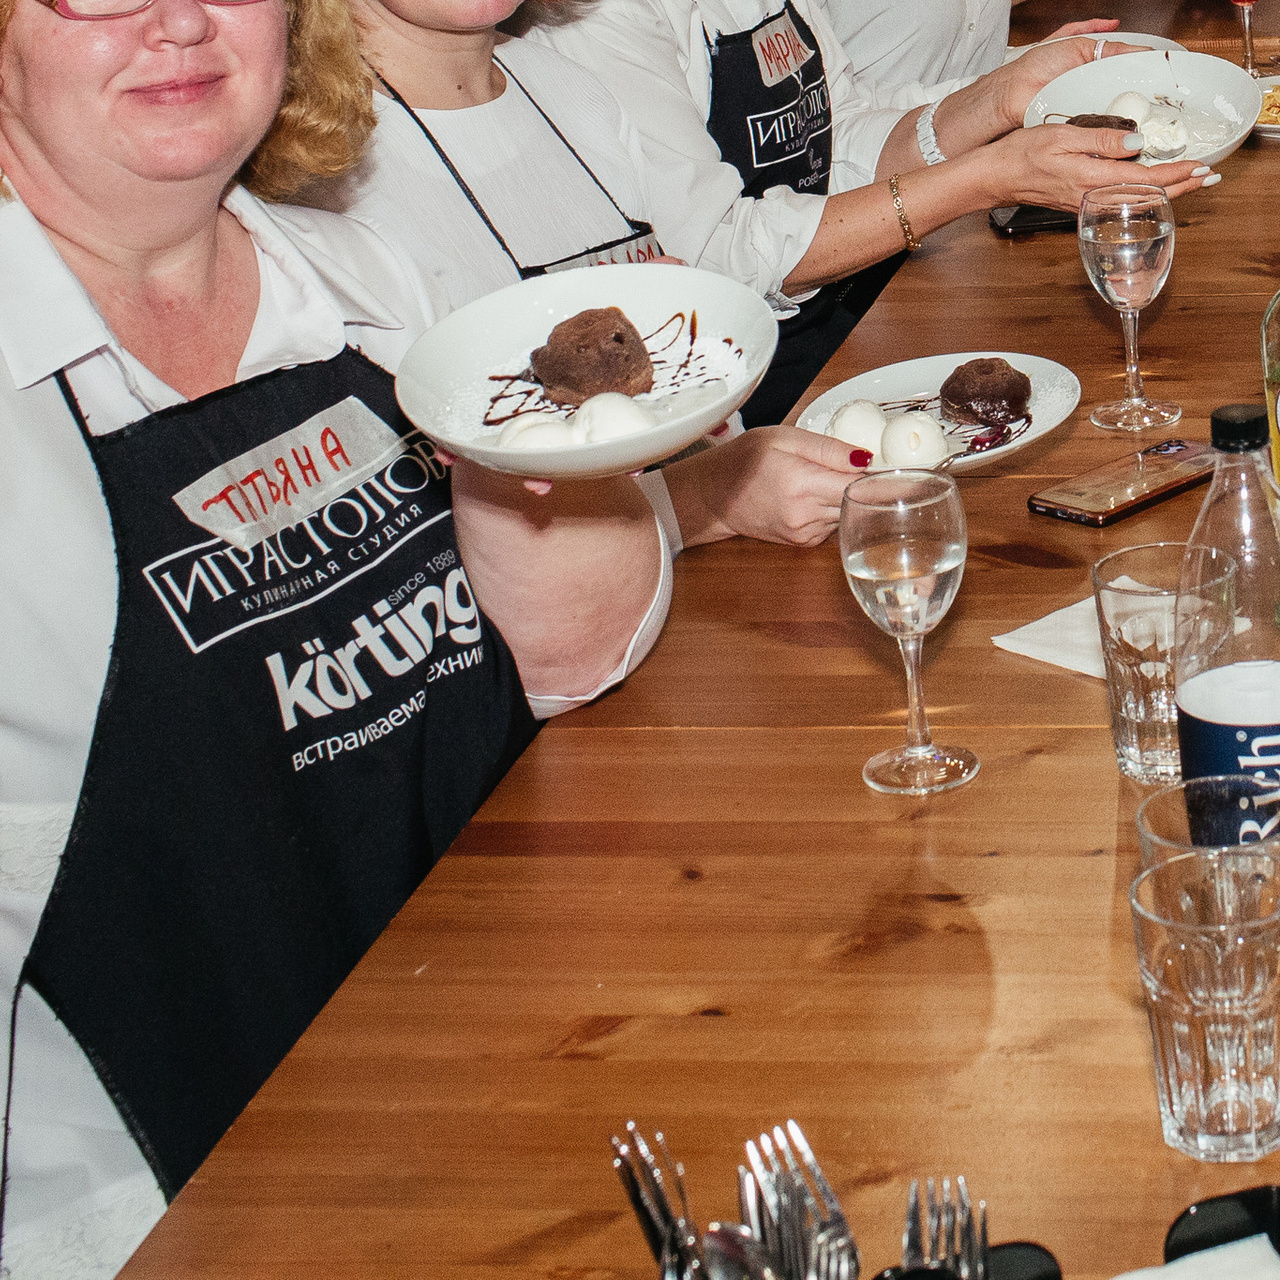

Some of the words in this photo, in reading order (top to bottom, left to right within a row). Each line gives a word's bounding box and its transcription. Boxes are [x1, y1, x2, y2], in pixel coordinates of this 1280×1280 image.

[347, 503, 423, 561] СТУДИЯ
[388, 572, 426, 606] since
[425, 549, 456, 573] 1889
[265, 567, 482, 732] körting
[292, 687, 427, 771] встраиваема
